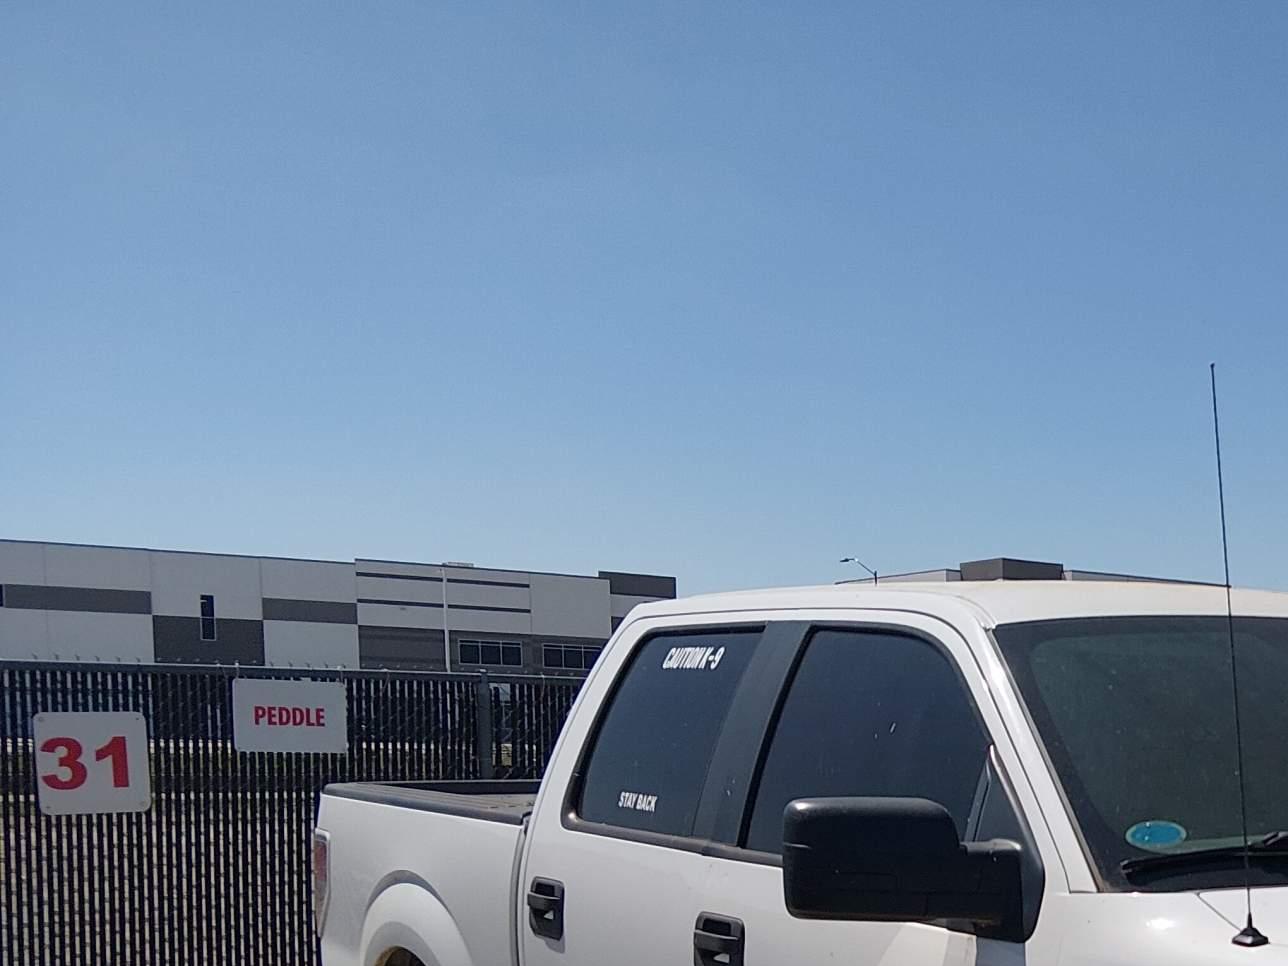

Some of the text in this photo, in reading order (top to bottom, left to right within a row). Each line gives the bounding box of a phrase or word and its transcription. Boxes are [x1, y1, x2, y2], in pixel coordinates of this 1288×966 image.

[662, 646, 725, 669] CAUTION K-9
[254, 705, 326, 727] PEDDLE
[40, 736, 130, 790] 31
[618, 791, 657, 812] STAY BACK
